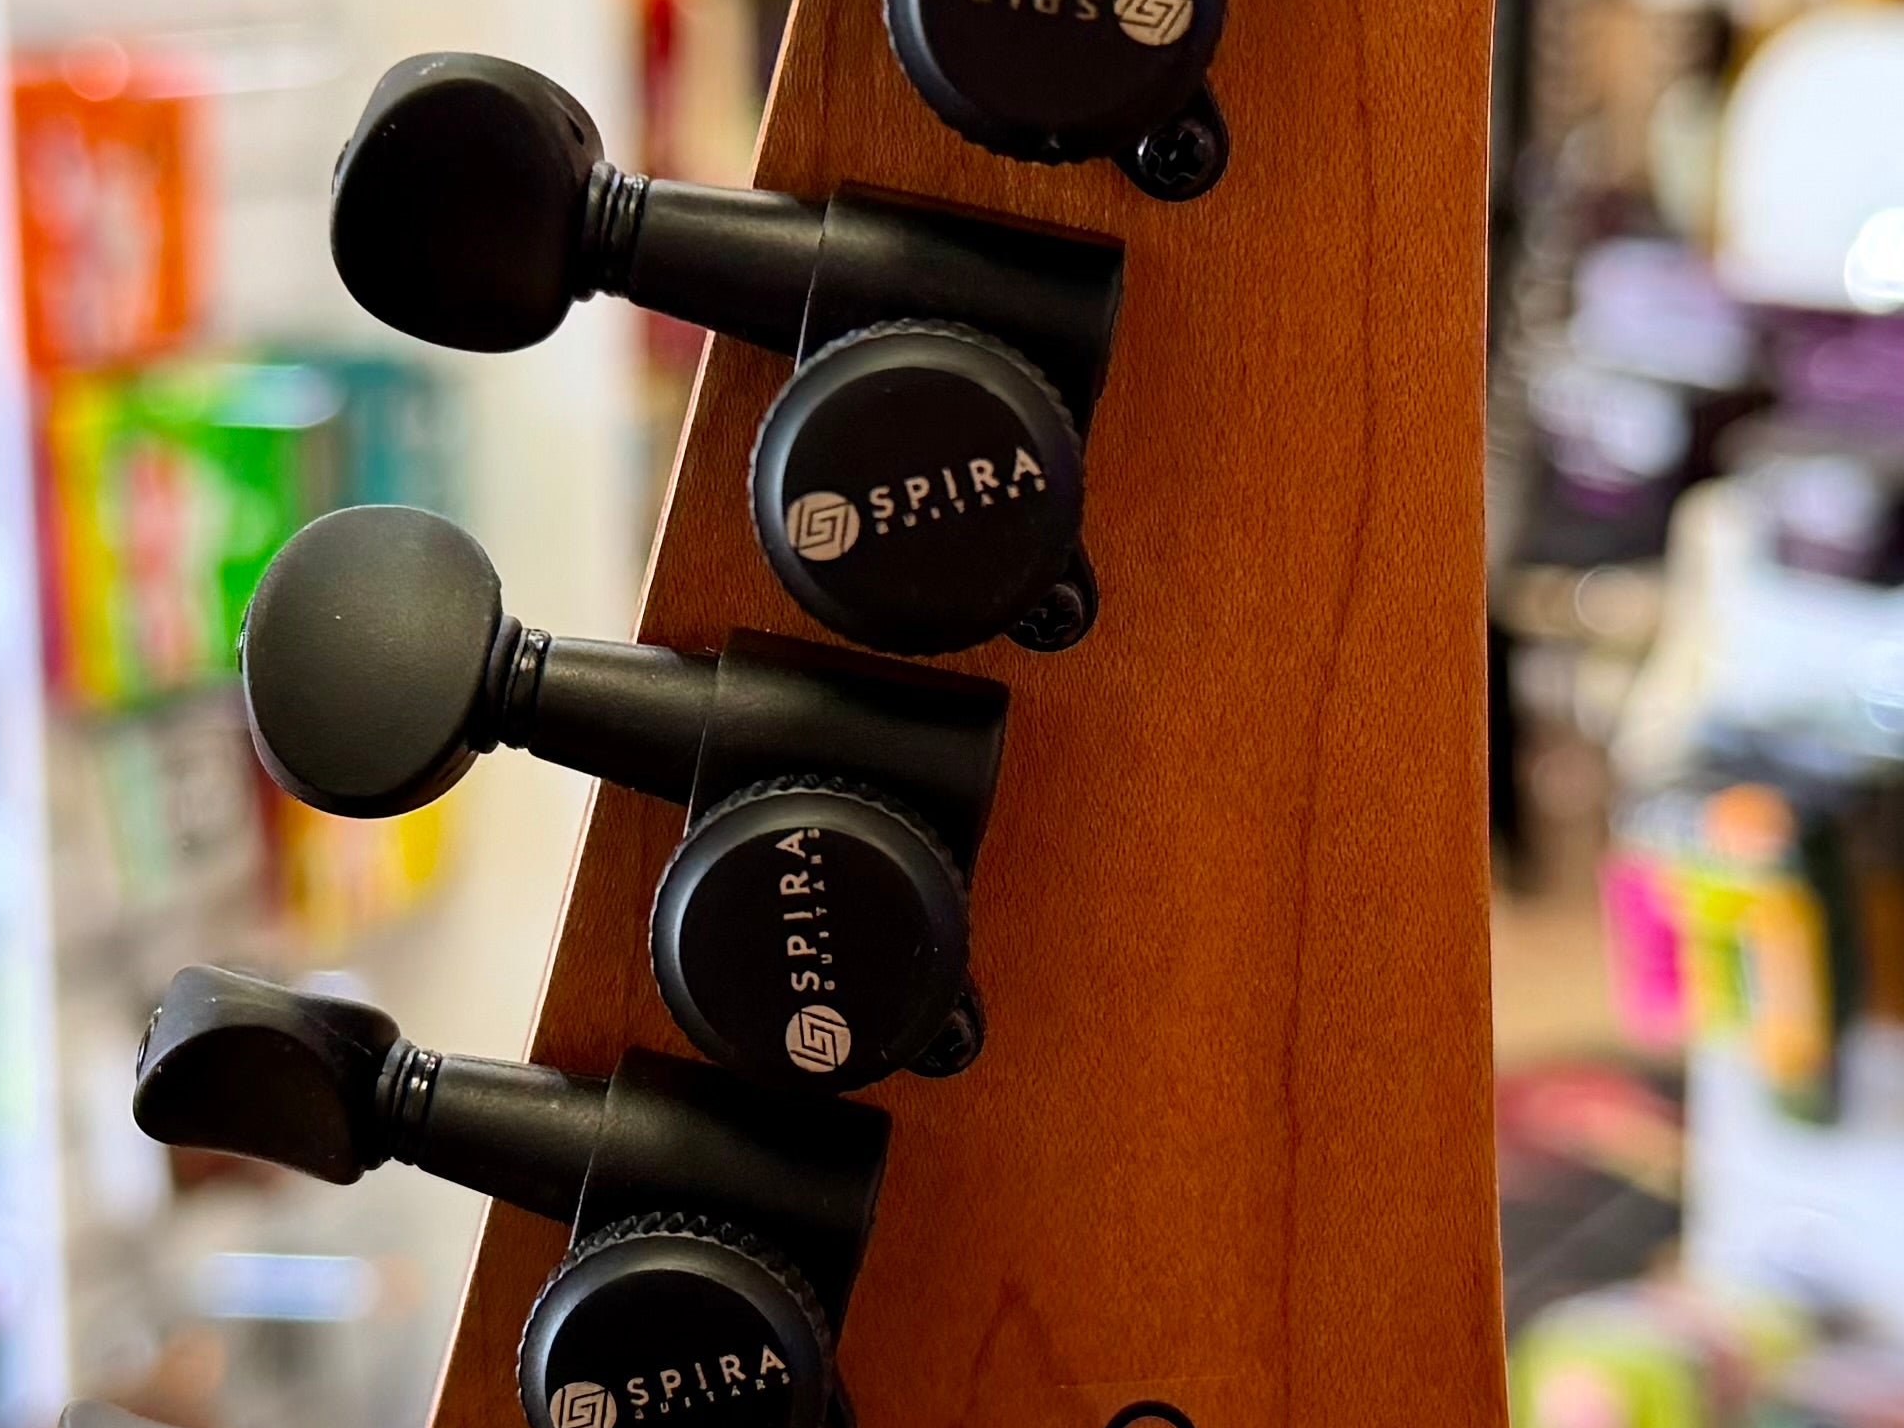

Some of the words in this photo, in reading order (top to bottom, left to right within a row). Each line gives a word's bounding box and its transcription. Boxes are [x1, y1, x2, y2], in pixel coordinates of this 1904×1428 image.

[868, 446, 1042, 520] SPIRA
[775, 829, 821, 992] SPIRA
[627, 1344, 787, 1407] SPIRA
